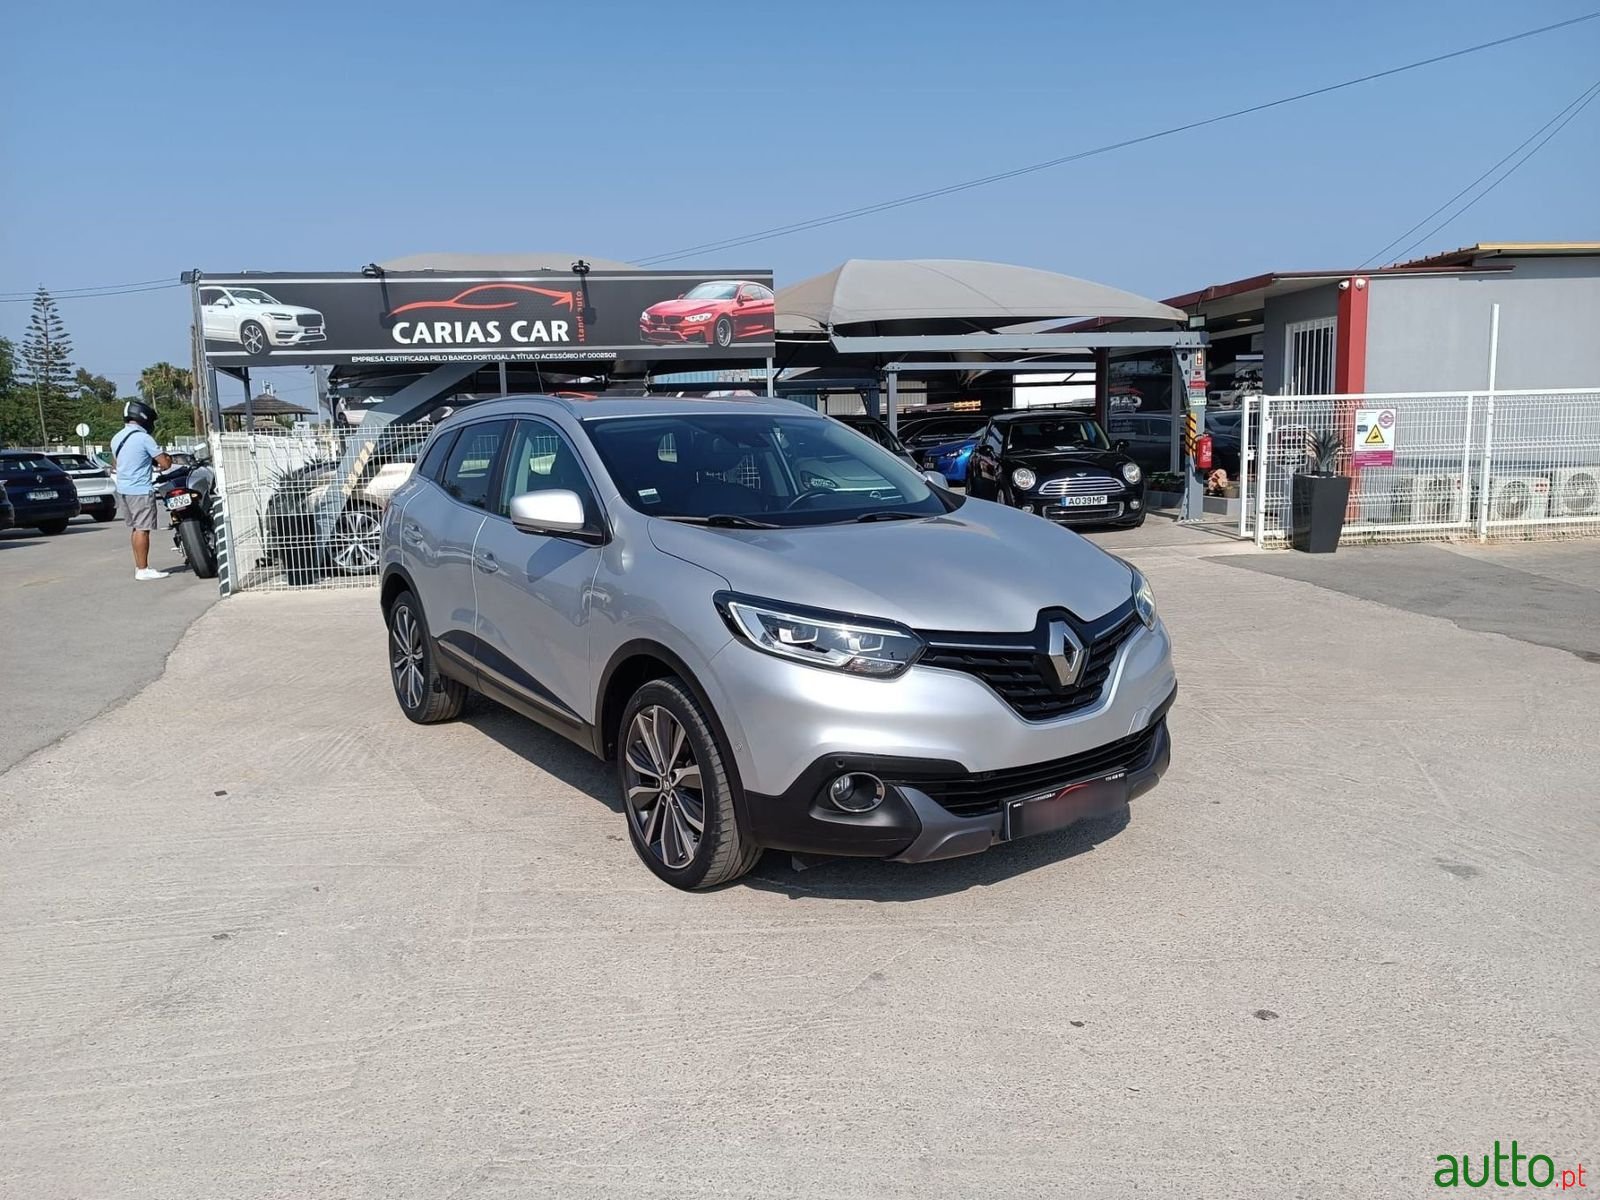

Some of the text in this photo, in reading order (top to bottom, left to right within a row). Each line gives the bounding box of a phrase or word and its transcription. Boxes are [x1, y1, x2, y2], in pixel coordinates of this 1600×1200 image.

[575, 290, 585, 342] stand auto
[392, 320, 570, 344] CARIAS CAR
[351, 355, 384, 363] EMPRESA
[385, 354, 429, 362] CERTIFICADA
[430, 354, 447, 362] PELO
[473, 353, 509, 361] PORTUGAL
[516, 352, 540, 360] TÍTULO
[541, 352, 578, 360] ACESSÓRIO
[1068, 496, 1105, 505] AO39MP
